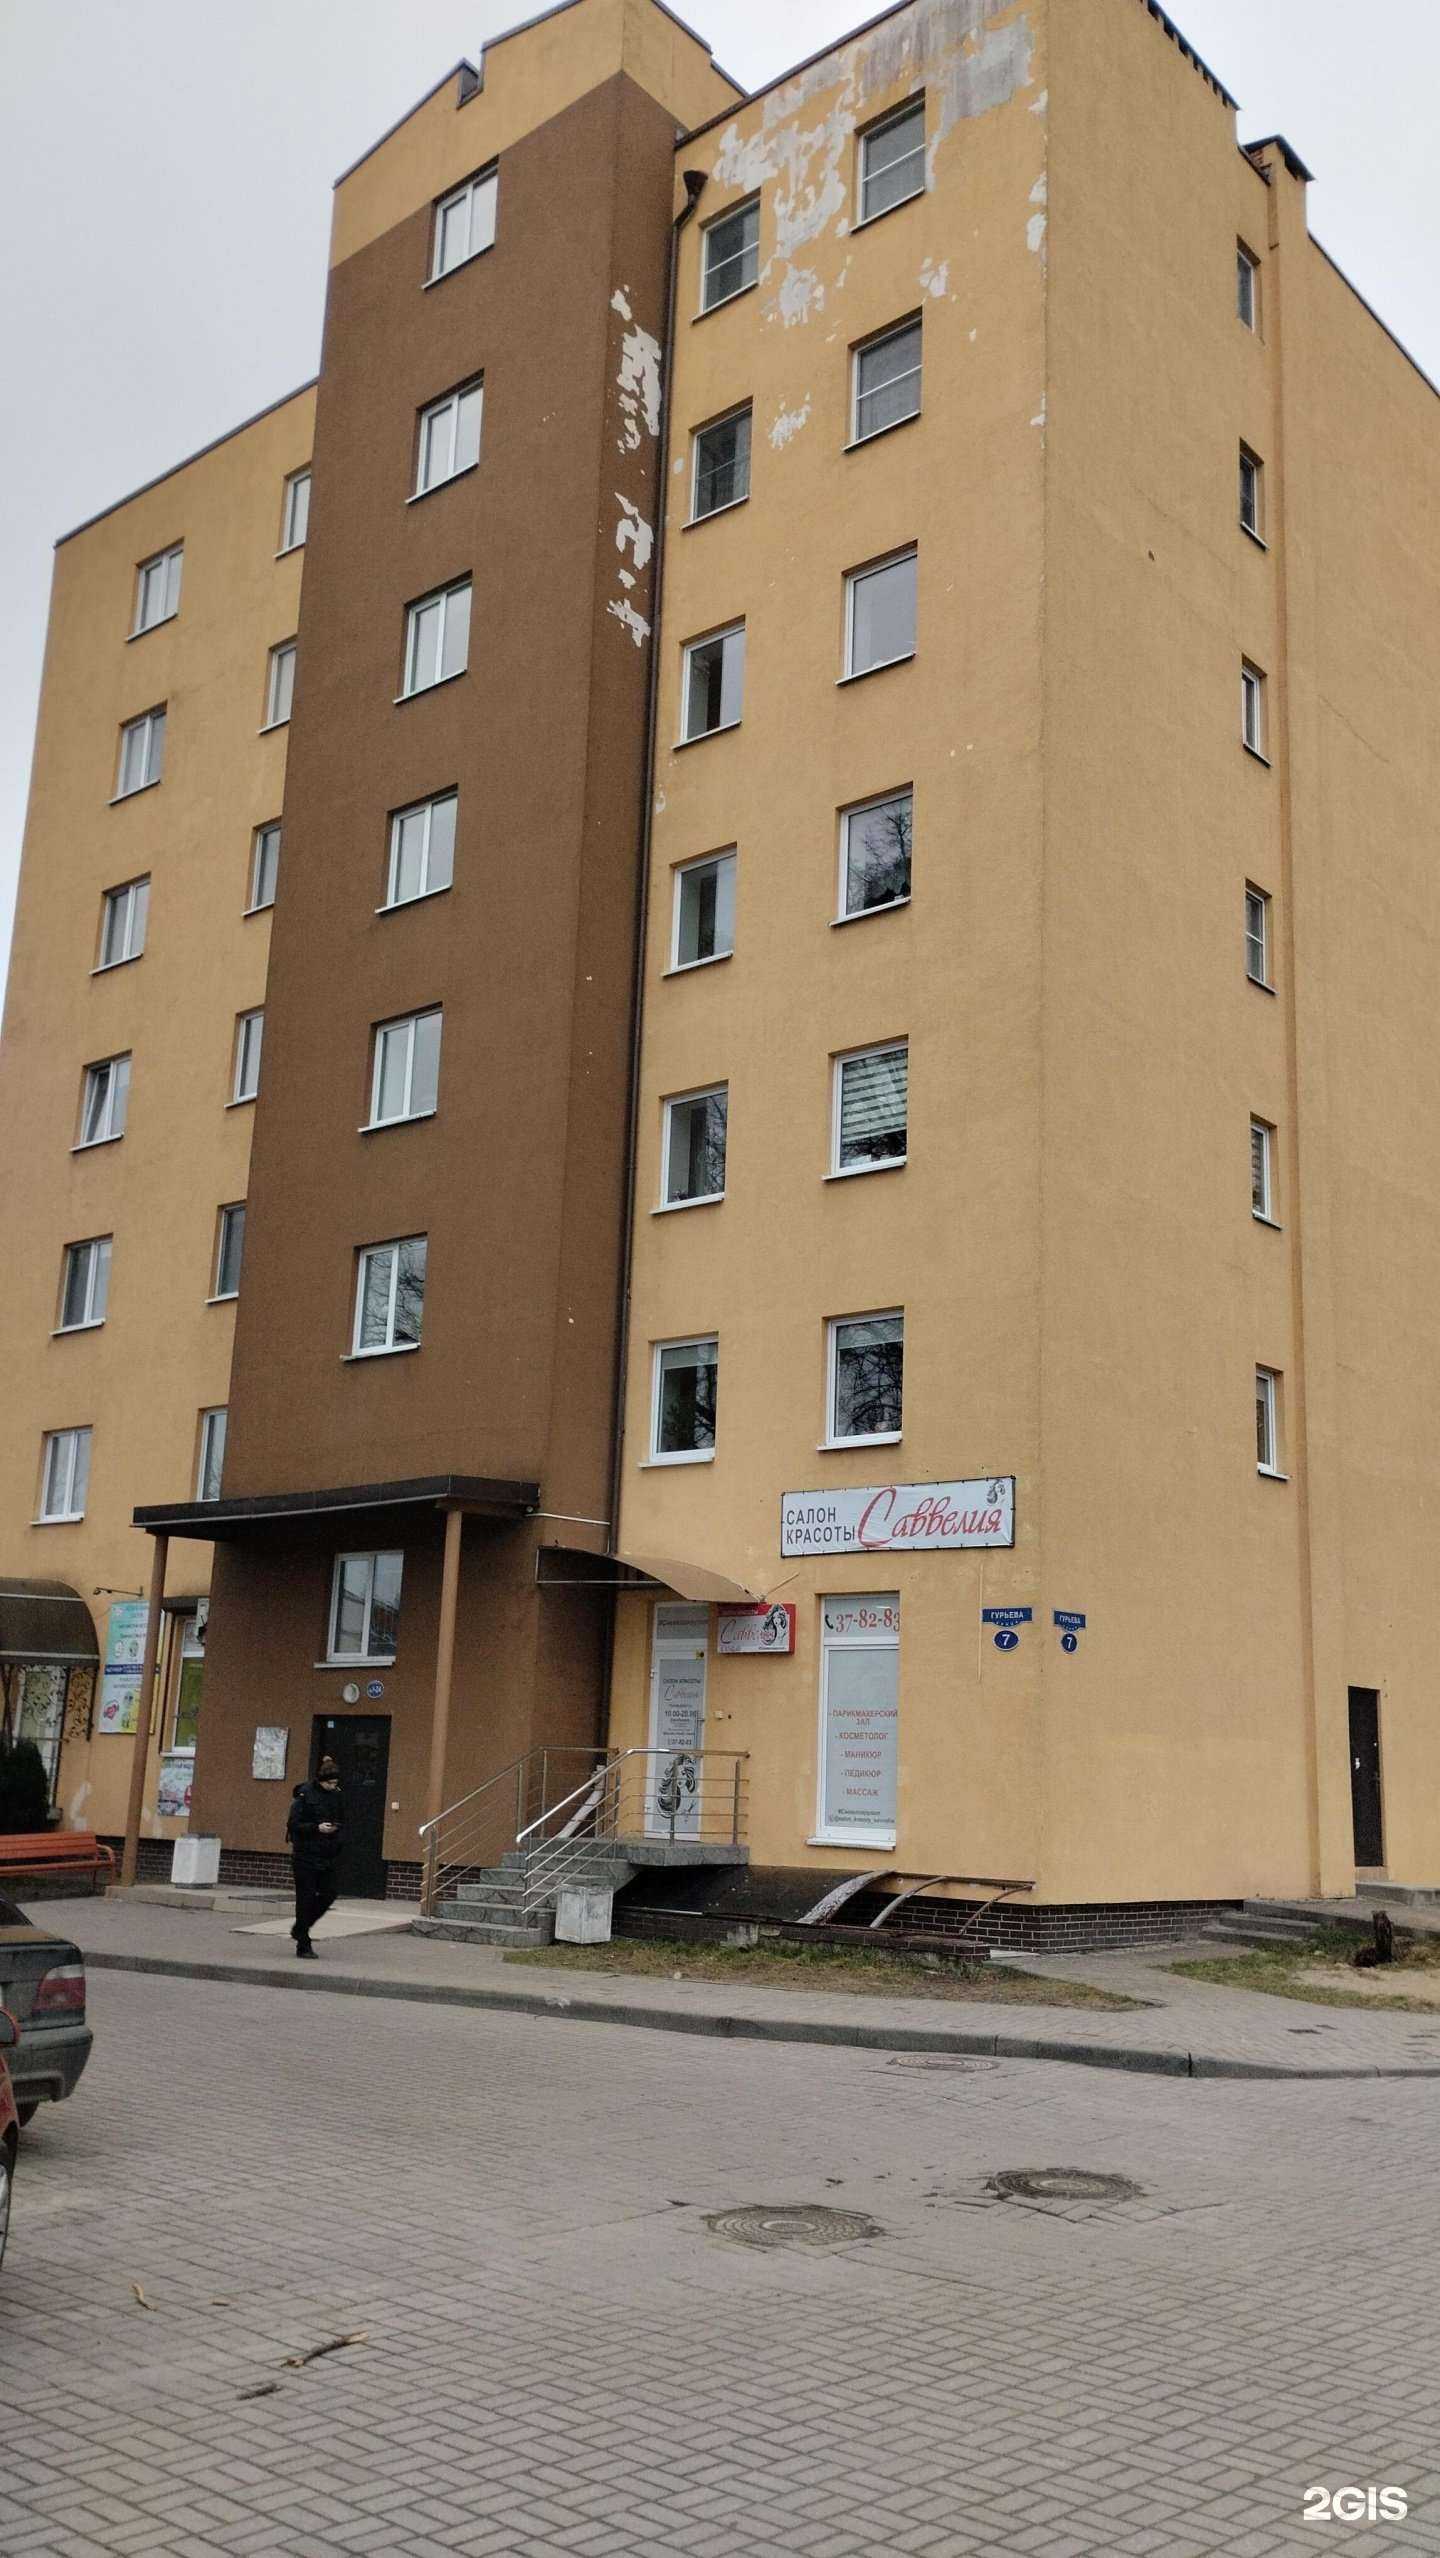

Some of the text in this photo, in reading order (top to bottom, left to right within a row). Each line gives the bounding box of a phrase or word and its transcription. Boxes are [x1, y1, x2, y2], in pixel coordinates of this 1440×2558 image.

[786, 1507, 836, 1526] САЛОН
[858, 1487, 1002, 1548] Саввелия
[786, 1526, 856, 1545] КРАСОТЫ
[836, 1608, 900, 1633] 37-82-83
[990, 1611, 1024, 1619] ГУРЬЕВА
[1059, 1615, 1081, 1624] ГУРЬЕВА
[1002, 1634, 1010, 1646] 7
[1067, 1637, 1073, 1649] 7
